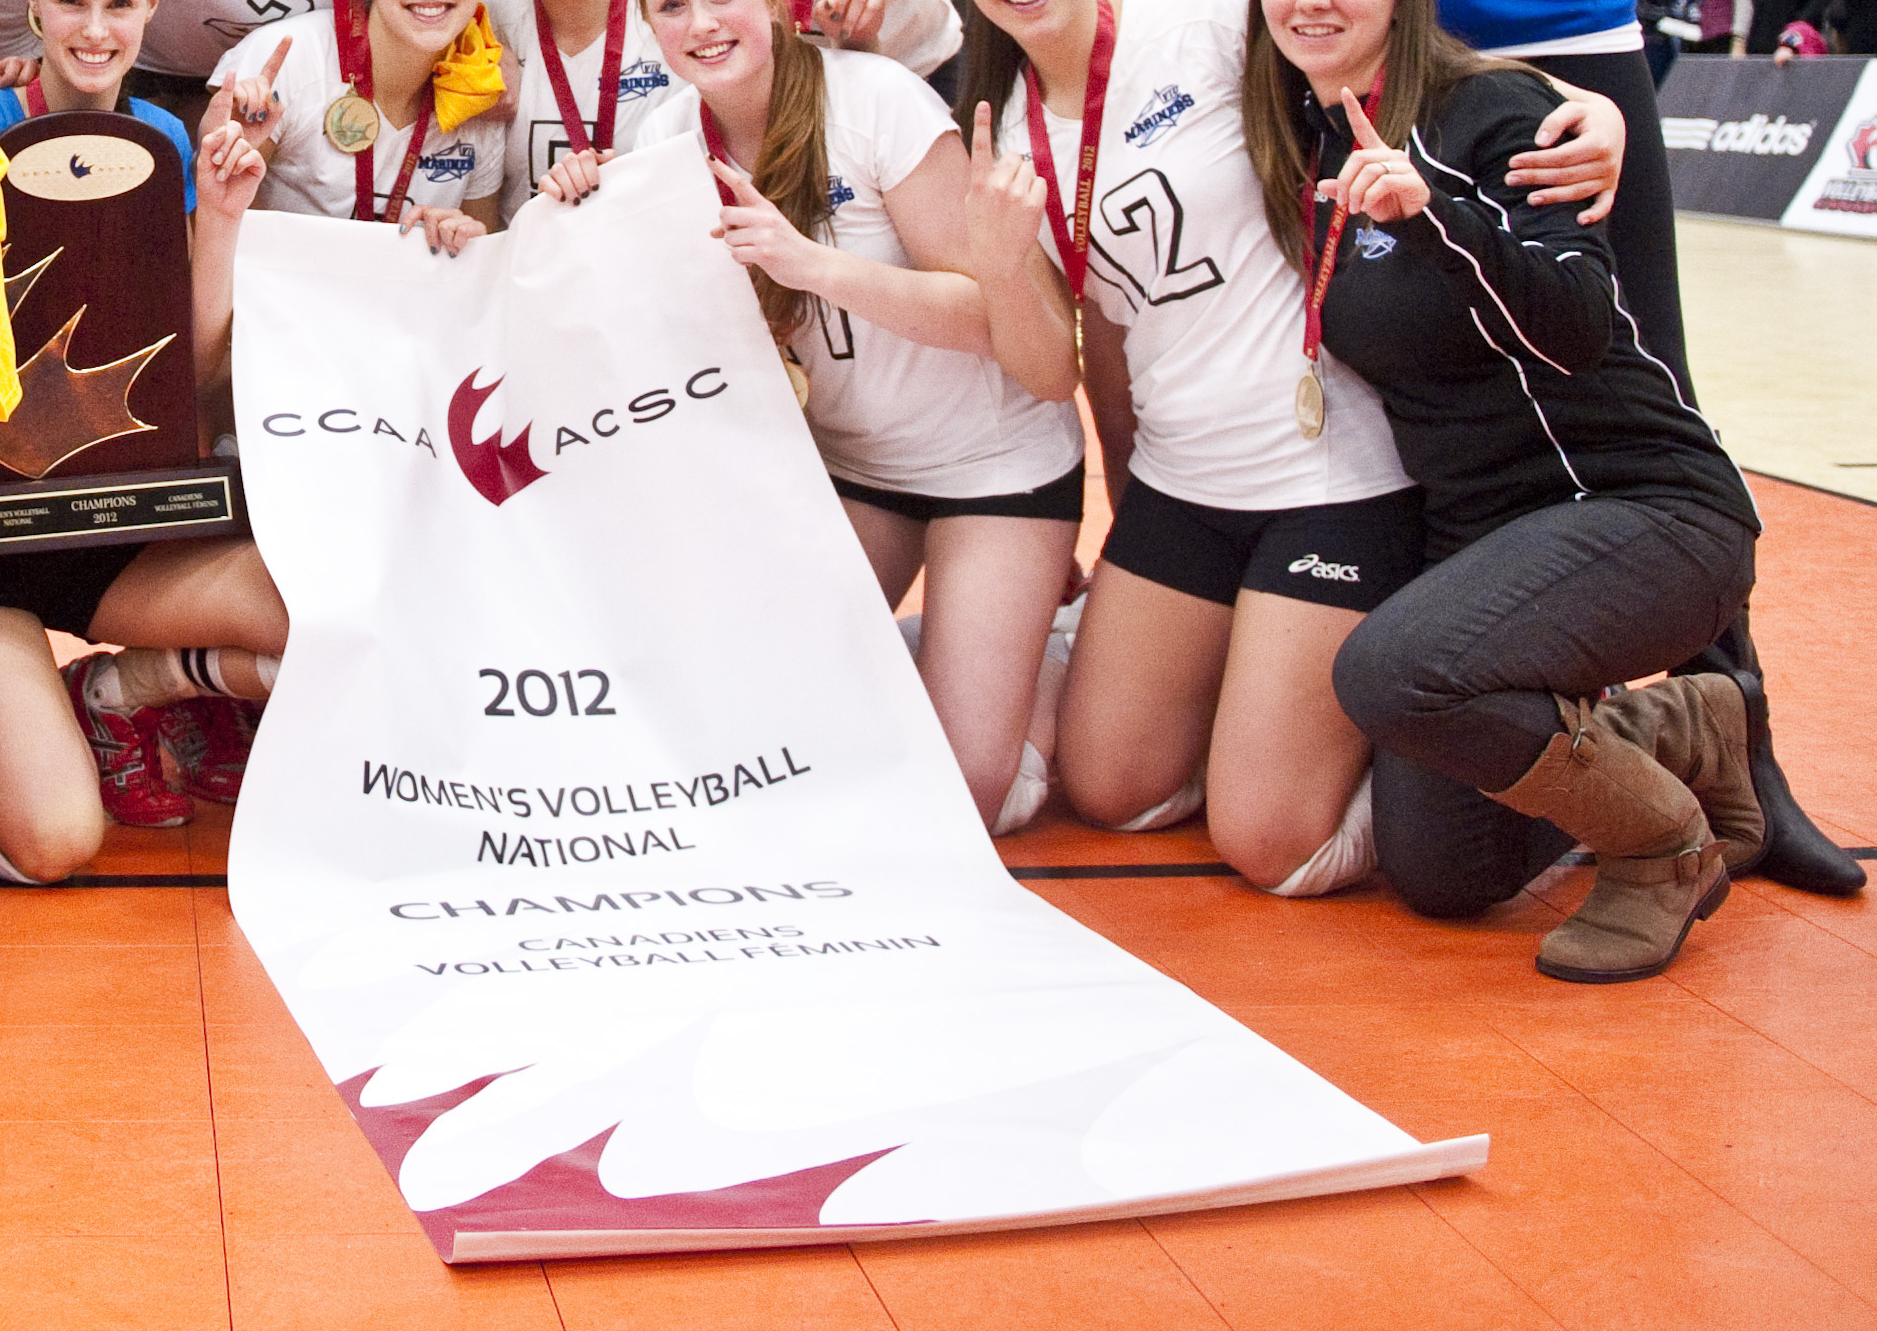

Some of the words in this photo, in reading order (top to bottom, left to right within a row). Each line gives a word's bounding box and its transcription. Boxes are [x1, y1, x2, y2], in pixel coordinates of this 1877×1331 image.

[598, 74, 670, 91] RINERS
[1124, 93, 1195, 143] MARINERS
[1711, 115, 1812, 156] adidas
[1083, 145, 1096, 171] 2012
[385, 183, 406, 223] EYBALL
[1074, 178, 1094, 254] VOLLEYBALL
[1312, 237, 1337, 309] VOLLEYBALL
[262, 408, 438, 459] CCAA
[555, 367, 729, 456] ACSC
[13, 508, 51, 518] VOLLEYBALL
[70, 495, 137, 512] CHAMPIONS
[93, 512, 118, 524] 2012
[154, 502, 192, 512] VOLLEYBALL
[1311, 561, 1360, 582] asics
[478, 667, 617, 717] 2012
[363, 760, 532, 818] WOMEN'S
[538, 746, 812, 818] VOLLEYBALL
[477, 827, 697, 868] NATIONAL
[389, 880, 855, 921] CHAMPIONS
[415, 950, 735, 976] VOLLEYBALL
[739, 934, 943, 961] FÉMININ
[518, 925, 806, 952] CANADIENS
